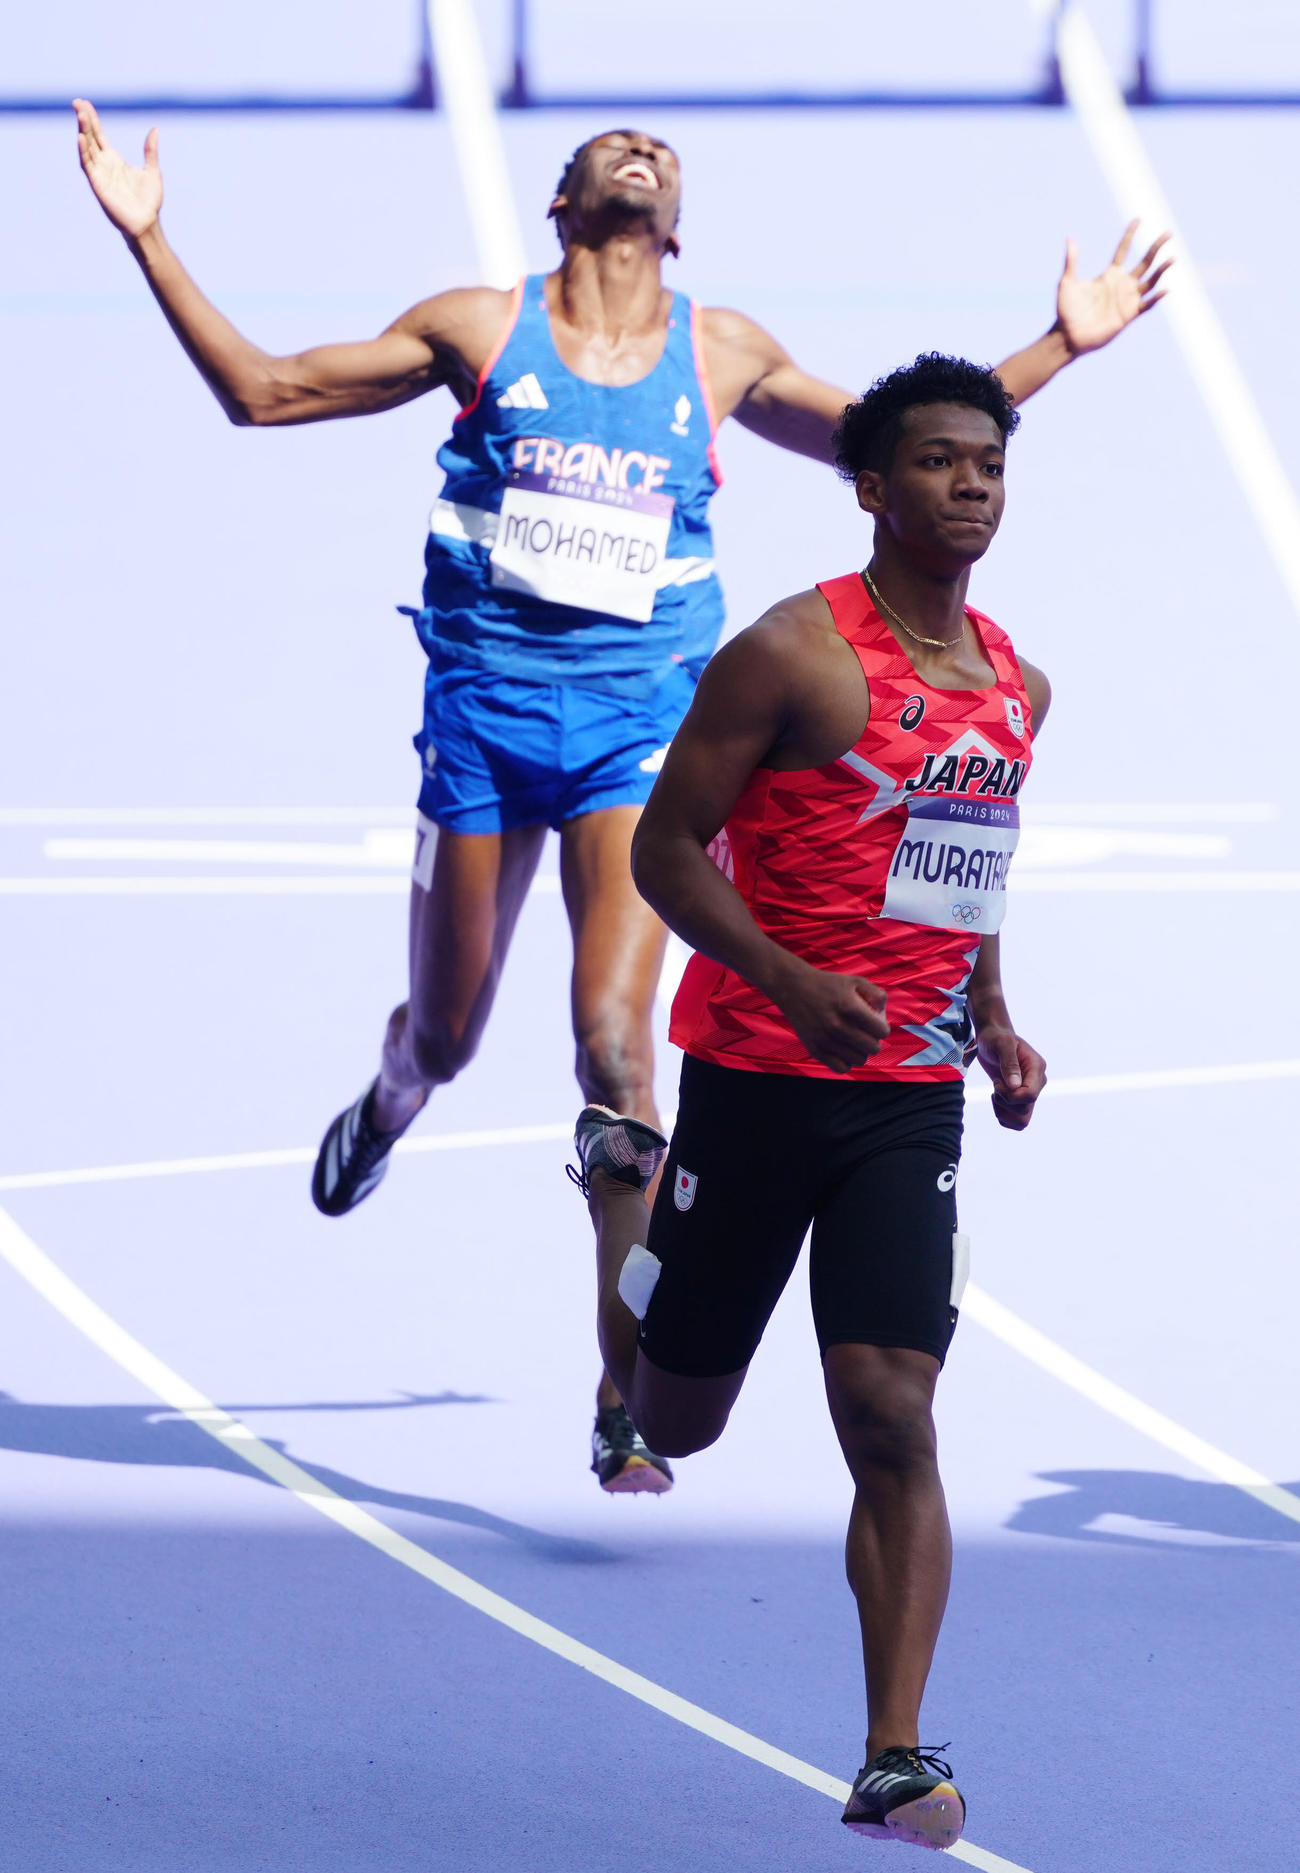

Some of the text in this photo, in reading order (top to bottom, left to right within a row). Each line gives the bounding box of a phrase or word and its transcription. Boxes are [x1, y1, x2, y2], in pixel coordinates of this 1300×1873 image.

[514, 437, 671, 495] FRANCE
[547, 477, 591, 499] PARIS
[504, 515, 657, 574] MOHAMED
[904, 753, 1026, 798] JAPAN
[950, 803, 1010, 821] PARIS 2024
